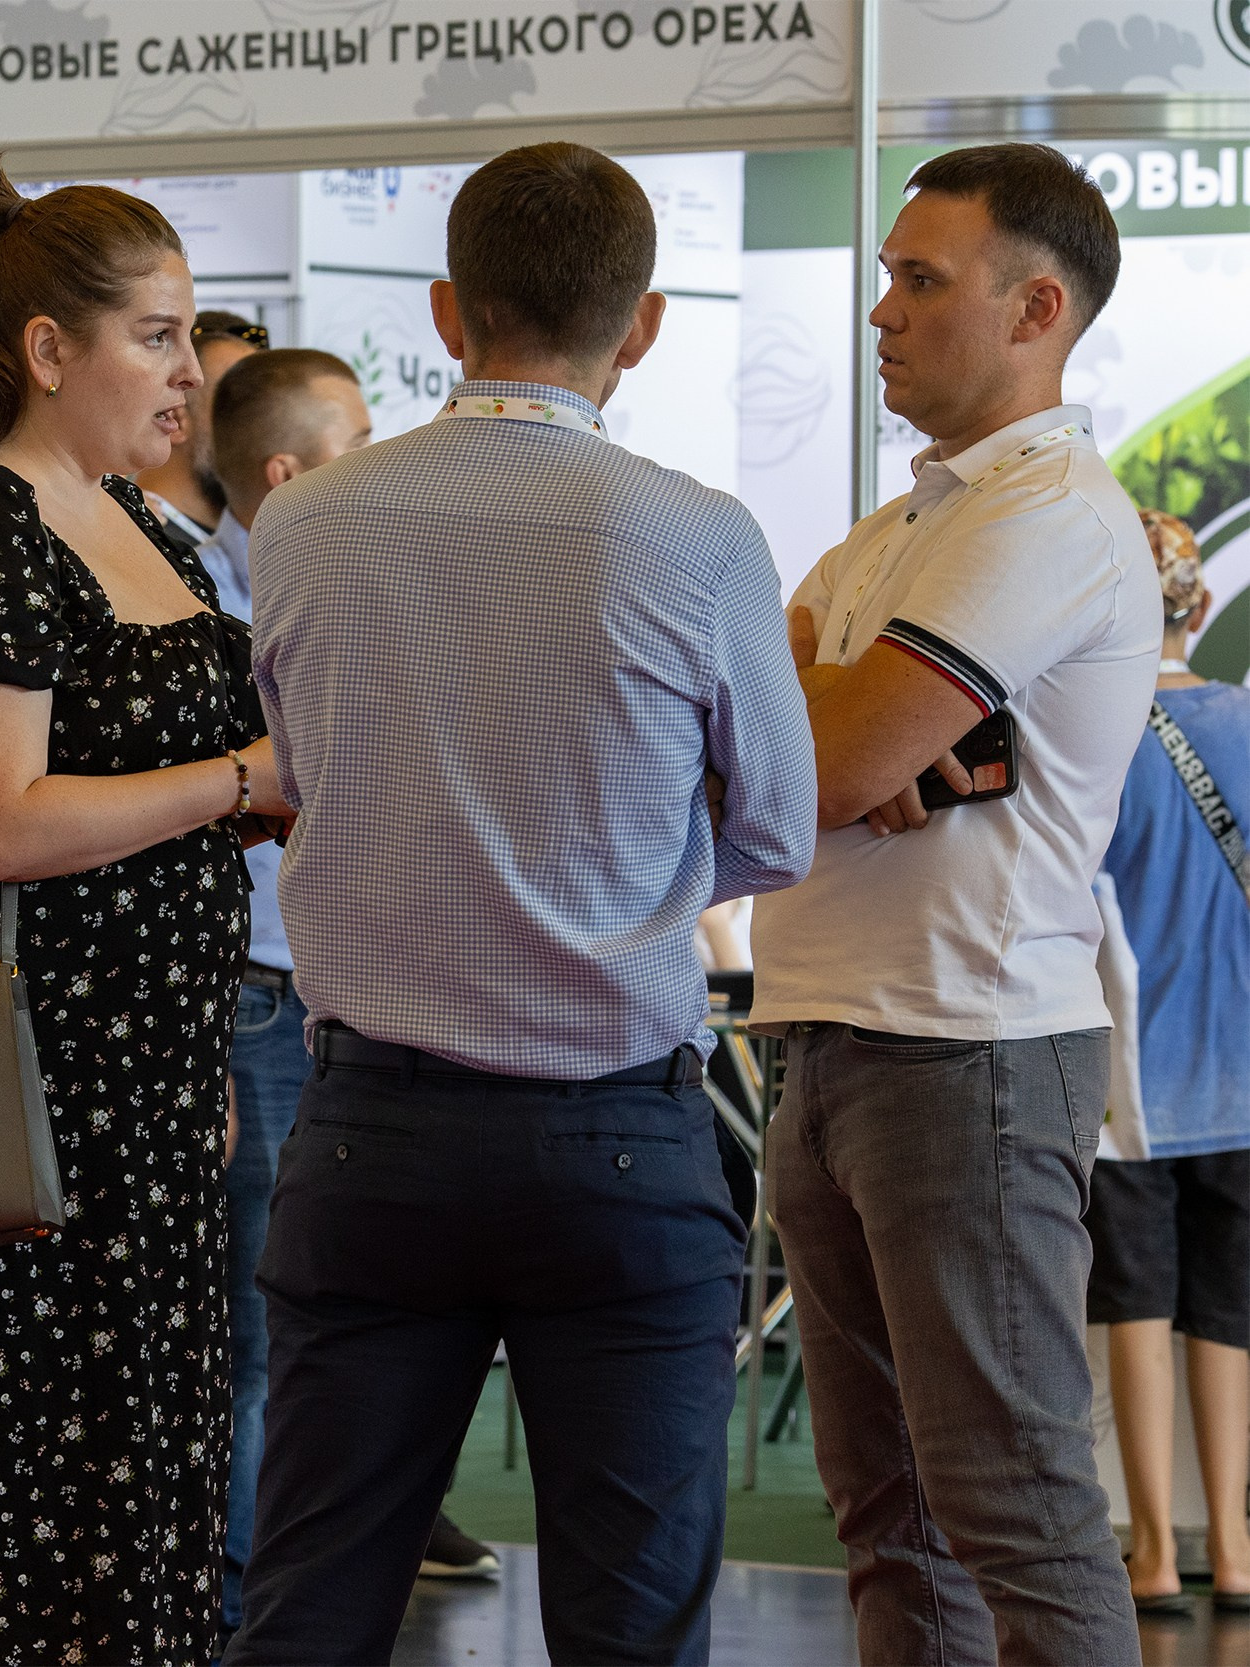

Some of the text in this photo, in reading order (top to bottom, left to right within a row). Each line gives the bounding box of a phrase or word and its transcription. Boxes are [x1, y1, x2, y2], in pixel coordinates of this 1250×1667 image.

[137, 27, 368, 75] САЖЕНЦЫ
[391, 10, 634, 64] ГРЕЦКОГО
[653, 1, 814, 47] ОРЕХА
[1075, 147, 1250, 211] ОВЫ
